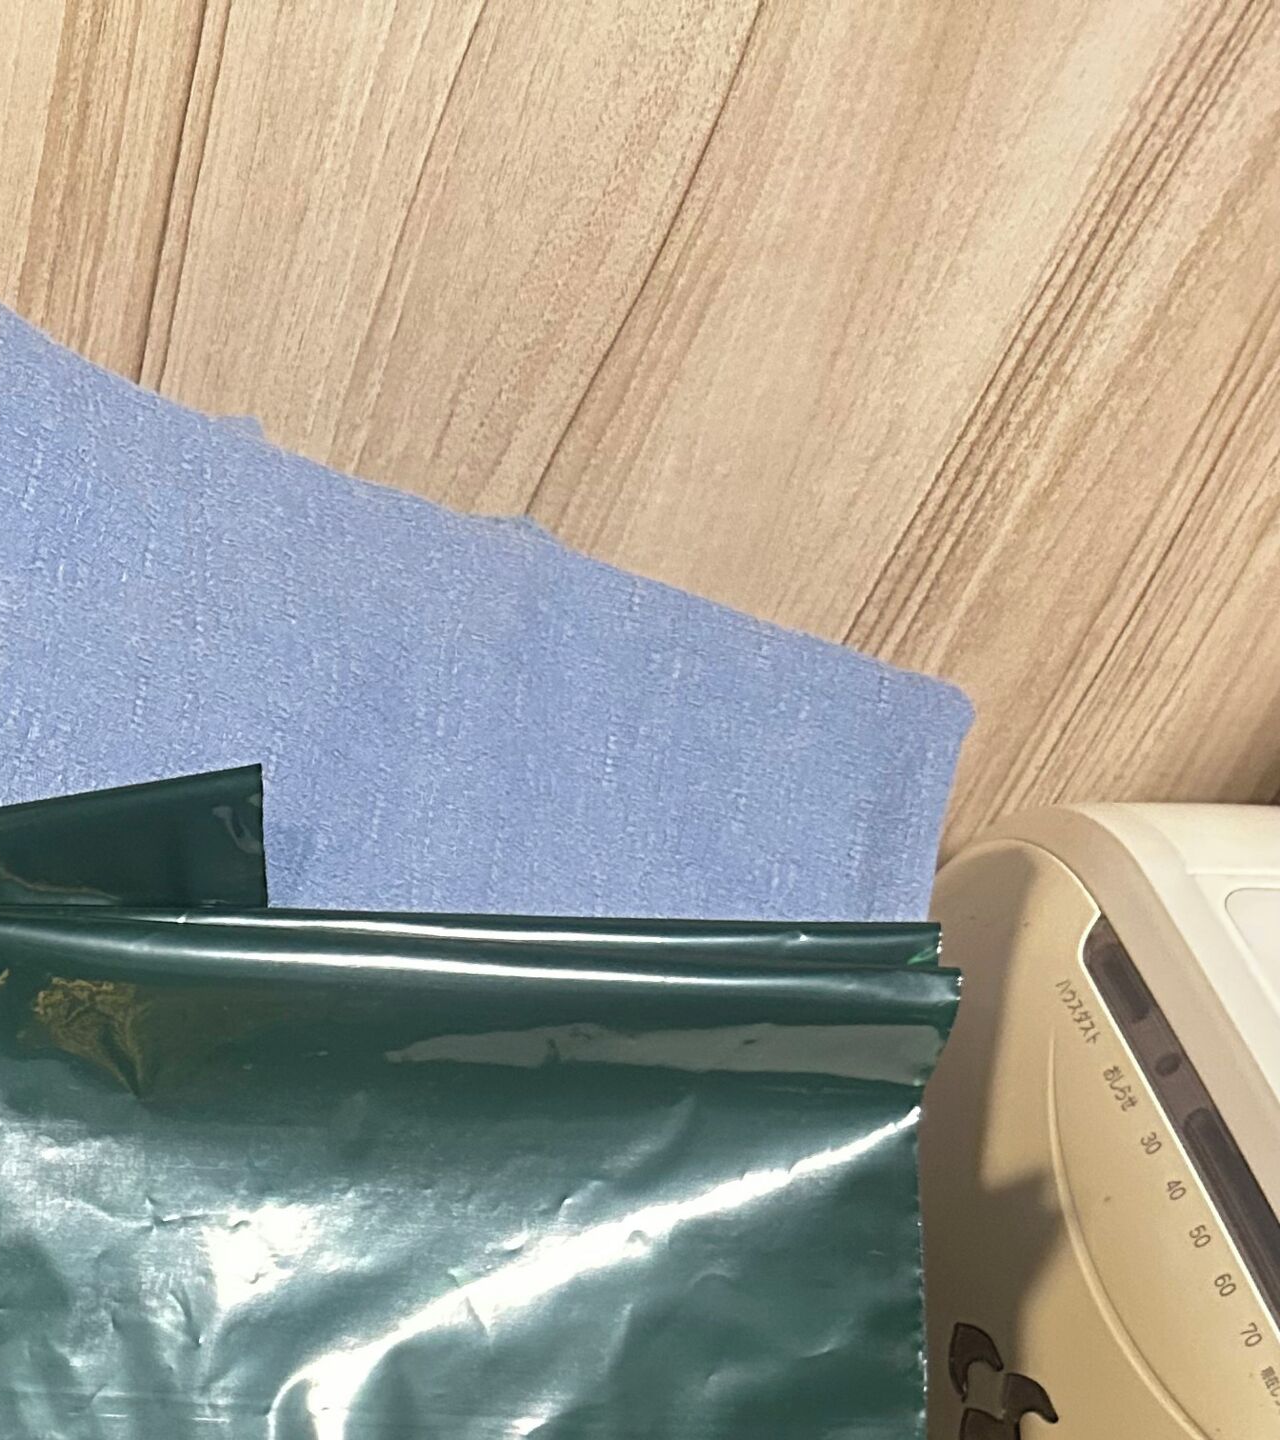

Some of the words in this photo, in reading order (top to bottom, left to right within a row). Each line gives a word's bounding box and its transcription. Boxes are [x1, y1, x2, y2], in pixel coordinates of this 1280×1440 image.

[1056, 979, 1101, 1044] ハウスダスト
[1103, 1066, 1138, 1111] おしらせ
[1140, 1131, 1163, 1155] 30
[1166, 1179, 1187, 1201] 40
[1189, 1224, 1212, 1248] 50
[1214, 1273, 1237, 1297] 60
[1240, 1322, 1263, 1347] 70
